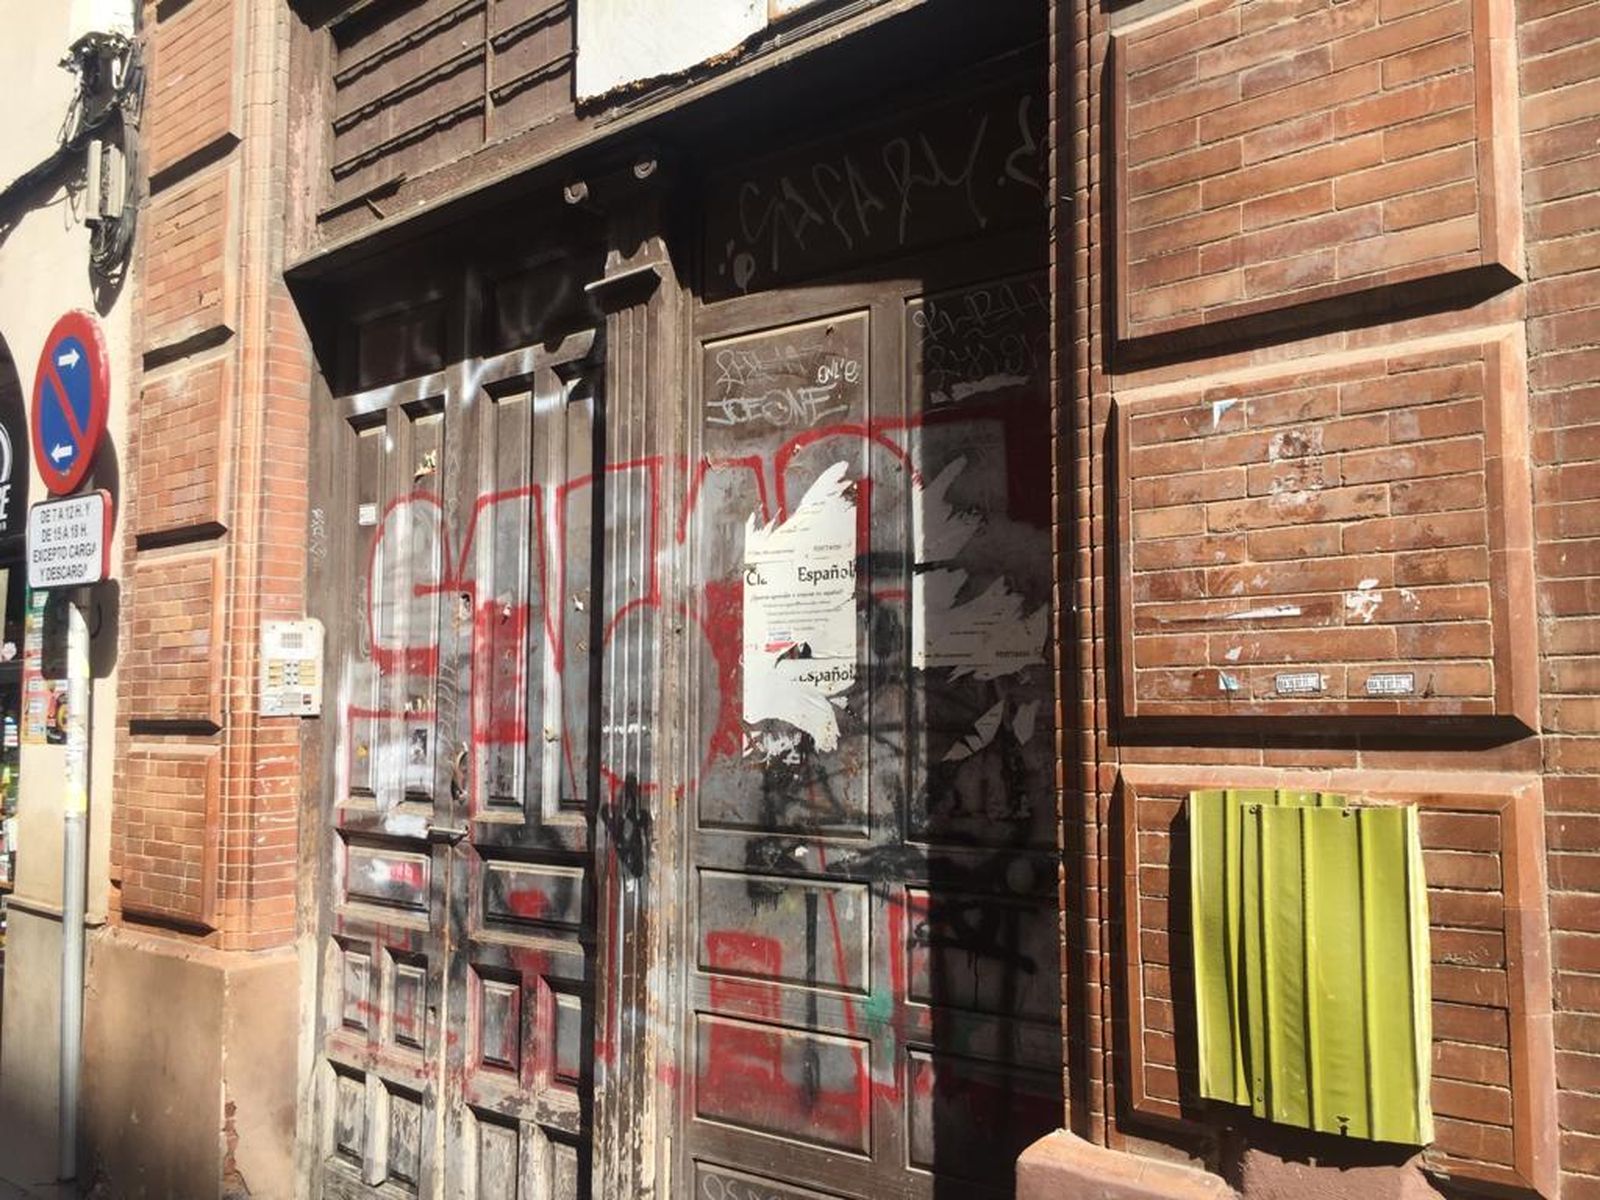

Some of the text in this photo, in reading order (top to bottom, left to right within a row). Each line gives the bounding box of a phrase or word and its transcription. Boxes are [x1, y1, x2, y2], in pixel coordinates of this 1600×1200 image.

[41, 508, 51, 524] DE
[41, 527, 51, 543] DE
[33, 541, 97, 563] EXCEPTO CARGA
[46, 563, 88, 581] DESCARGA
[797, 560, 855, 586] Español
